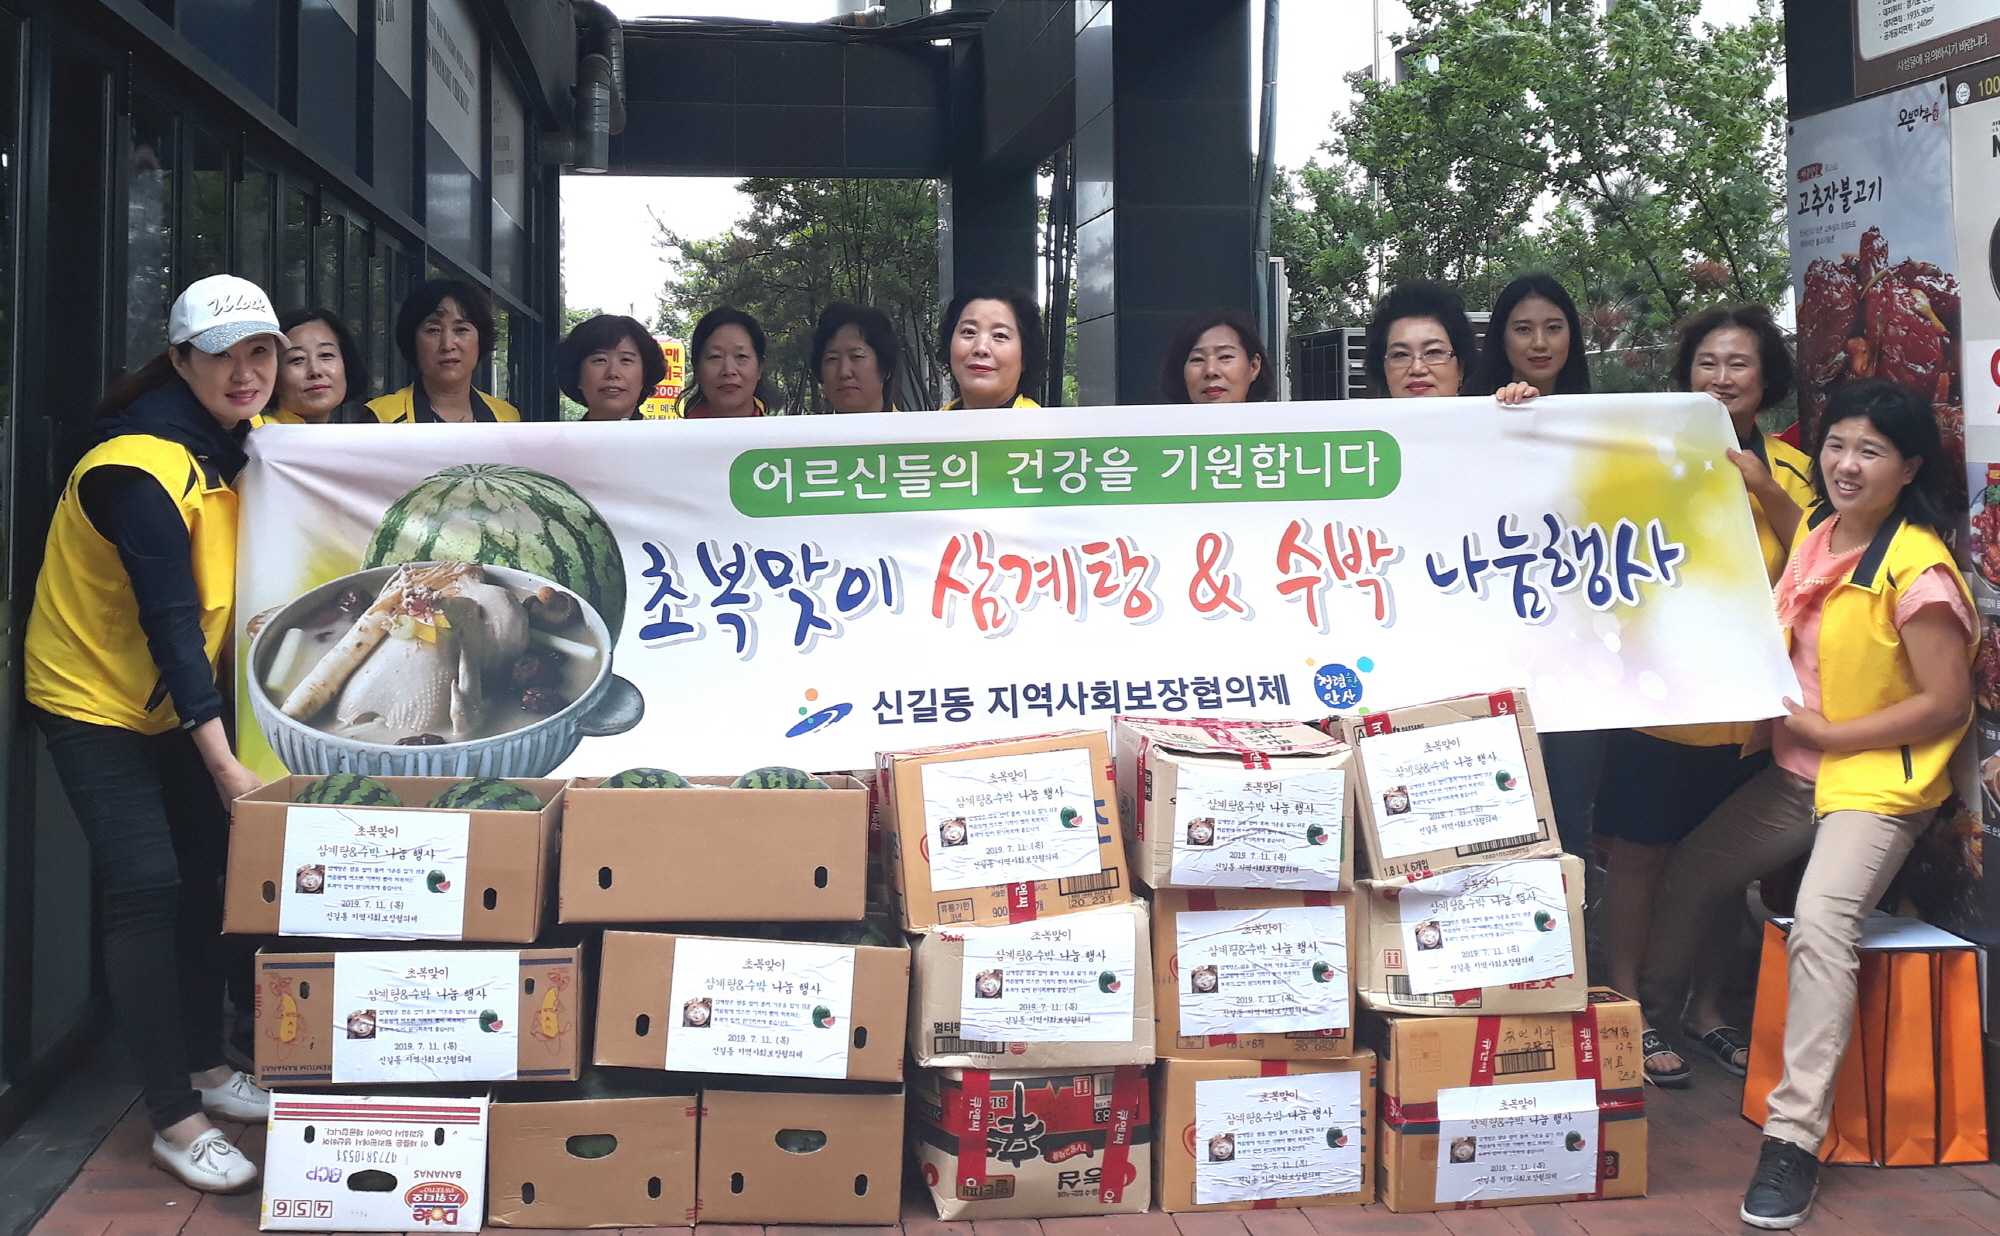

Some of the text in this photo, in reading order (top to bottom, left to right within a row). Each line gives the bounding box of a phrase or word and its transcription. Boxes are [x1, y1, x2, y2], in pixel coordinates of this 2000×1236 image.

[1797, 175, 1883, 217] 고추장불고기
[752, 440, 1381, 505] 어르신들의 건강을 기원합니다
[638, 512, 1684, 656] 초복맞이 삼계탕 & 수박 나눔행사
[872, 673, 1291, 726] 신길동 지역사회보장협의체
[1323, 688, 1357, 705] 안산
[1423, 737, 1461, 754] 초복맞이
[1453, 755, 1474, 768] 나눔
[1477, 751, 1498, 765] 행사
[987, 768, 1028, 784] 초복맞이
[1018, 790, 1039, 801] 나눔
[1043, 786, 1064, 800] 행사
[1242, 781, 1283, 793] 초복맞이
[1269, 801, 1291, 813] 나눔
[1294, 802, 1315, 815] 행사
[354, 825, 399, 840] 초복맞이
[384, 847, 408, 861] 나눔
[413, 847, 436, 862] 행사
[1229, 851, 1247, 860] 2019.
[1261, 852, 1271, 861] 11.
[1274, 852, 1287, 863] (목)
[1384, 865, 1395, 877] 1.8
[1397, 864, 1402, 875] L
[1410, 858, 1429, 872] 6개입
[1460, 876, 1499, 893] 초복맞이
[341, 899, 361, 909] 2019.
[375, 900, 386, 910] 11.
[389, 900, 404, 911] (목)
[1070, 895, 1112, 908] 20 231
[1490, 894, 1511, 908] 나눔
[1516, 891, 1537, 904] 행사
[940, 902, 970, 914] 유통기한
[992, 906, 1008, 918] 900
[326, 912, 348, 923] 신길동
[1030, 928, 1072, 942] 초복맞이
[1241, 922, 1283, 936] 초복맞이
[1271, 943, 1293, 954] 나눔
[1296, 941, 1319, 953] 행사
[1059, 949, 1081, 963] 나눔
[1085, 949, 1107, 963] 행사
[742, 958, 786, 973] 초복맞이
[404, 966, 449, 980] 초복맞이
[436, 988, 460, 1002] 나눔
[463, 988, 488, 1002] 행사
[771, 980, 794, 995] 나눔
[799, 982, 822, 997] 행사
[1018, 1002, 1039, 1012] 2019.
[1050, 1002, 1062, 1012] 11.
[1065, 1002, 1078, 1013] (목)
[394, 1042, 414, 1051] 2019.
[428, 1042, 440, 1051] 11.
[443, 1041, 458, 1052] (목)
[727, 1033, 748, 1043] 2019.
[761, 1035, 772, 1044] 11.
[775, 1035, 790, 1046] (목)
[1580, 1027, 1594, 1063] 큐엔씨
[711, 1046, 734, 1057] 신길동
[1294, 1043, 1335, 1051] 20 052
[378, 1055, 401, 1066] 신길동
[1478, 1038, 1492, 1073] 큐엔씨
[1258, 1089, 1299, 1103] 초복맞이
[1499, 1097, 1538, 1111] 초복맞이
[968, 1096, 982, 1132] 큐엔씨
[1287, 1109, 1307, 1121] 나눔
[1312, 1106, 1333, 1120] 행사
[1529, 1113, 1549, 1126] 나눔
[1553, 1112, 1573, 1125] 행사
[986, 1081, 1046, 1169] 辛
[1112, 1109, 1129, 1145] 큐엔씨
[413, 1170, 462, 1179] BANANAS
[1057, 1167, 1102, 1190] 농심
[412, 1192, 460, 1202] 스위디오
[412, 1208, 459, 1226] Dole
